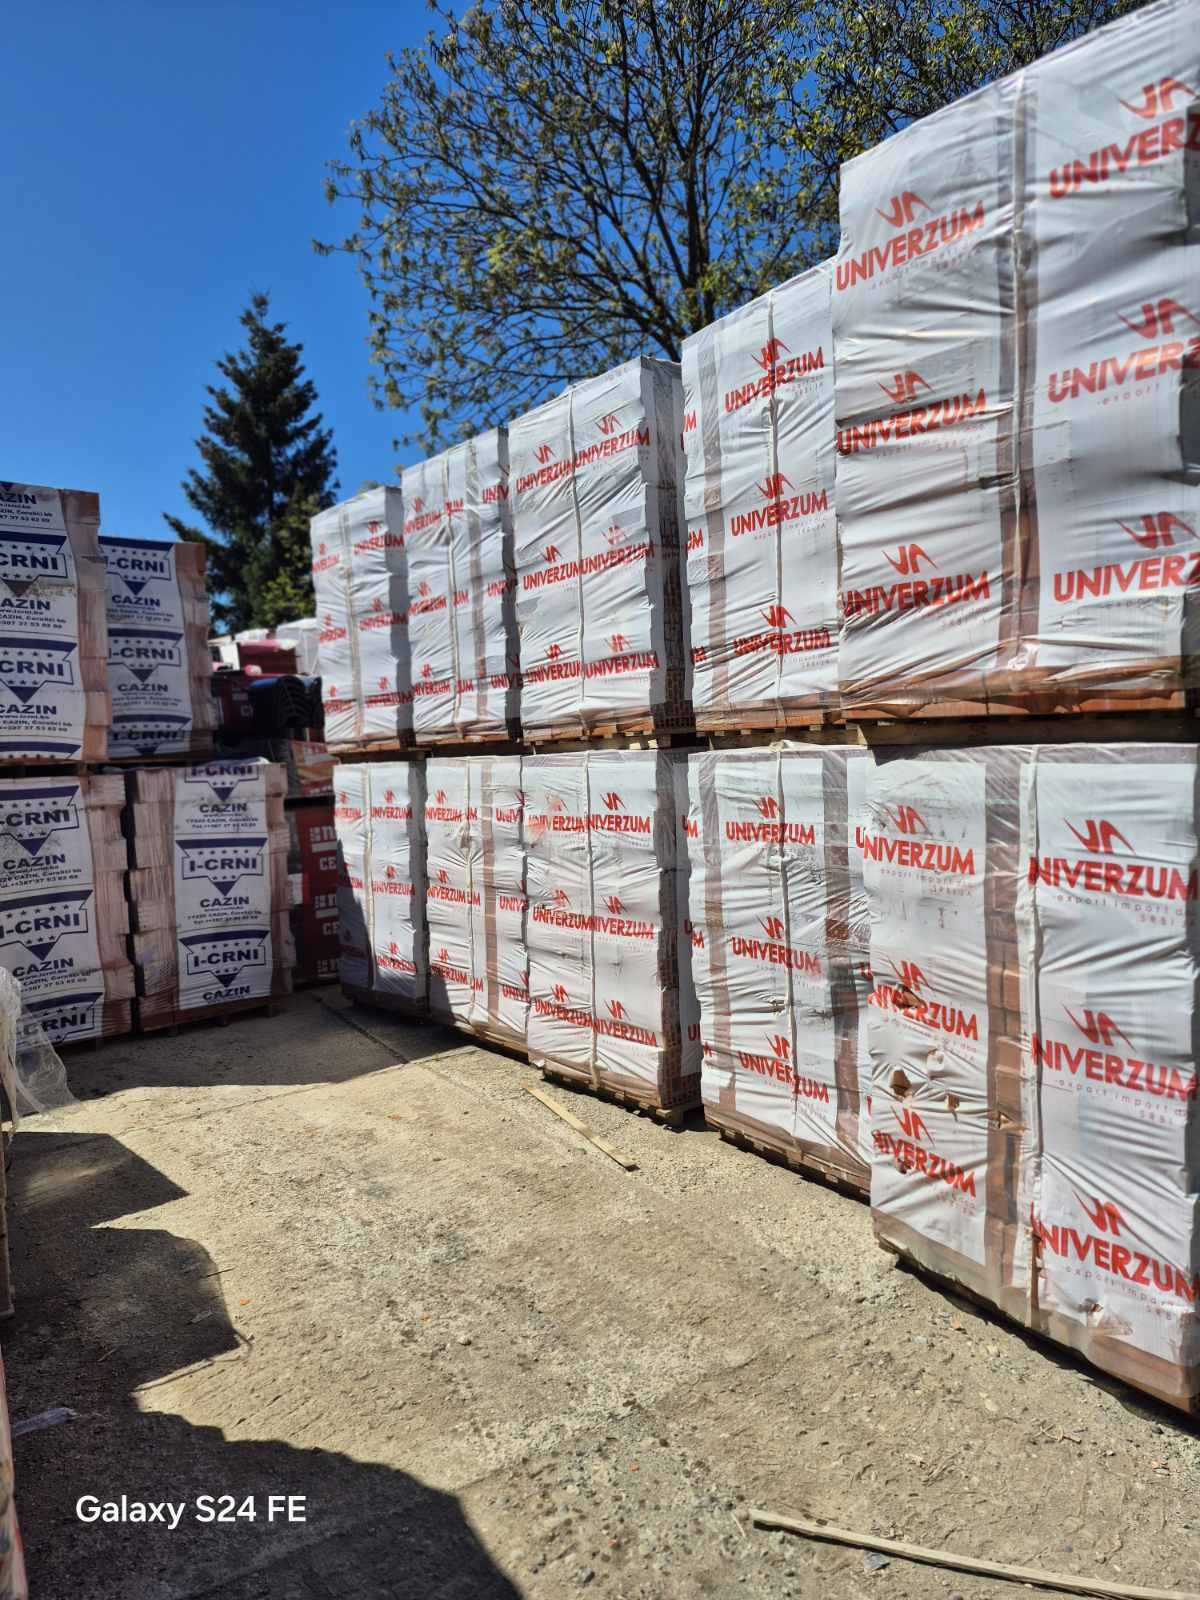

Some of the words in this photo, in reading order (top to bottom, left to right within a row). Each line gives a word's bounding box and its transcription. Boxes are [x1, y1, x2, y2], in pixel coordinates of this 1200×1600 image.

[836, 200, 985, 291] UNIVERZUM
[724, 346, 825, 413] UNIVERZUM
[837, 388, 986, 456] UNIVERZUM
[575, 427, 650, 468] UNIVERZUM
[730, 489, 829, 537] UNIVERZUM
[112, 595, 160, 607] CAZIN
[843, 570, 990, 617] UNIVERZUM
[0, 660, 64, 676] CRNI
[584, 651, 659, 679] UNIVERZUM
[118, 683, 168, 692] CAZIN
[199, 803, 247, 813] CAZIN
[370, 807, 413, 819] UNIVERZUM
[725, 821, 815, 845] UNIVERZUM
[855, 826, 976, 876] UNIVERZUM
[4, 854, 66, 870] CAZIN
[190, 857, 256, 872] I-CRNI
[372, 880, 415, 896] UNIVERZUM
[200, 896, 249, 908] CAZIN
[194, 949, 258, 967] I-CRNI
[732, 936, 822, 975] UNIVERZUM
[12, 958, 74, 978] CAZIN
[203, 985, 250, 1001] CAZIN
[737, 1051, 829, 1103] UNIVERZUM
